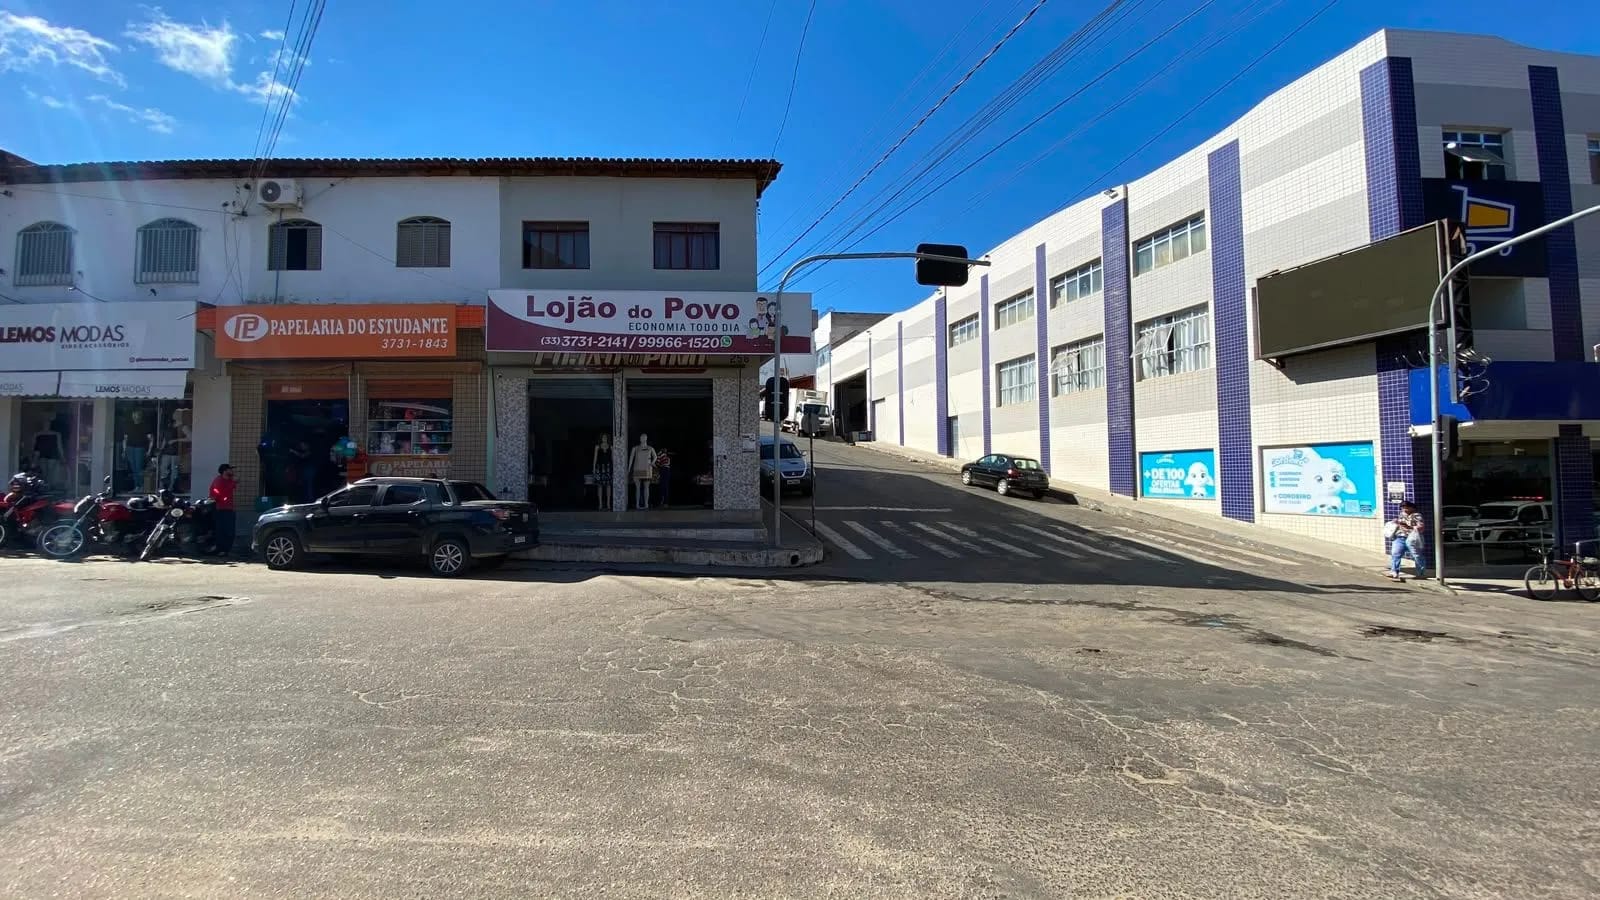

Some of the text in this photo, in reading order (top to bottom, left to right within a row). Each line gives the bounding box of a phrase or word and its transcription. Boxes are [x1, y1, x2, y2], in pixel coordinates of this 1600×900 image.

[526, 295, 740, 323] Lojão do Povo
[270, 317, 448, 336] PAPELARIA DO ESTUDANTE
[628, 322, 740, 332] ECONOMIA TODO DIA
[0, 325, 124, 343] LEMOS MODAS
[382, 338, 449, 349] 3731-1843
[562, 335, 628, 348] 3731-2141
[638, 336, 720, 349] 99966-1520
[95, 385, 151, 394] LEMOS MODAS
